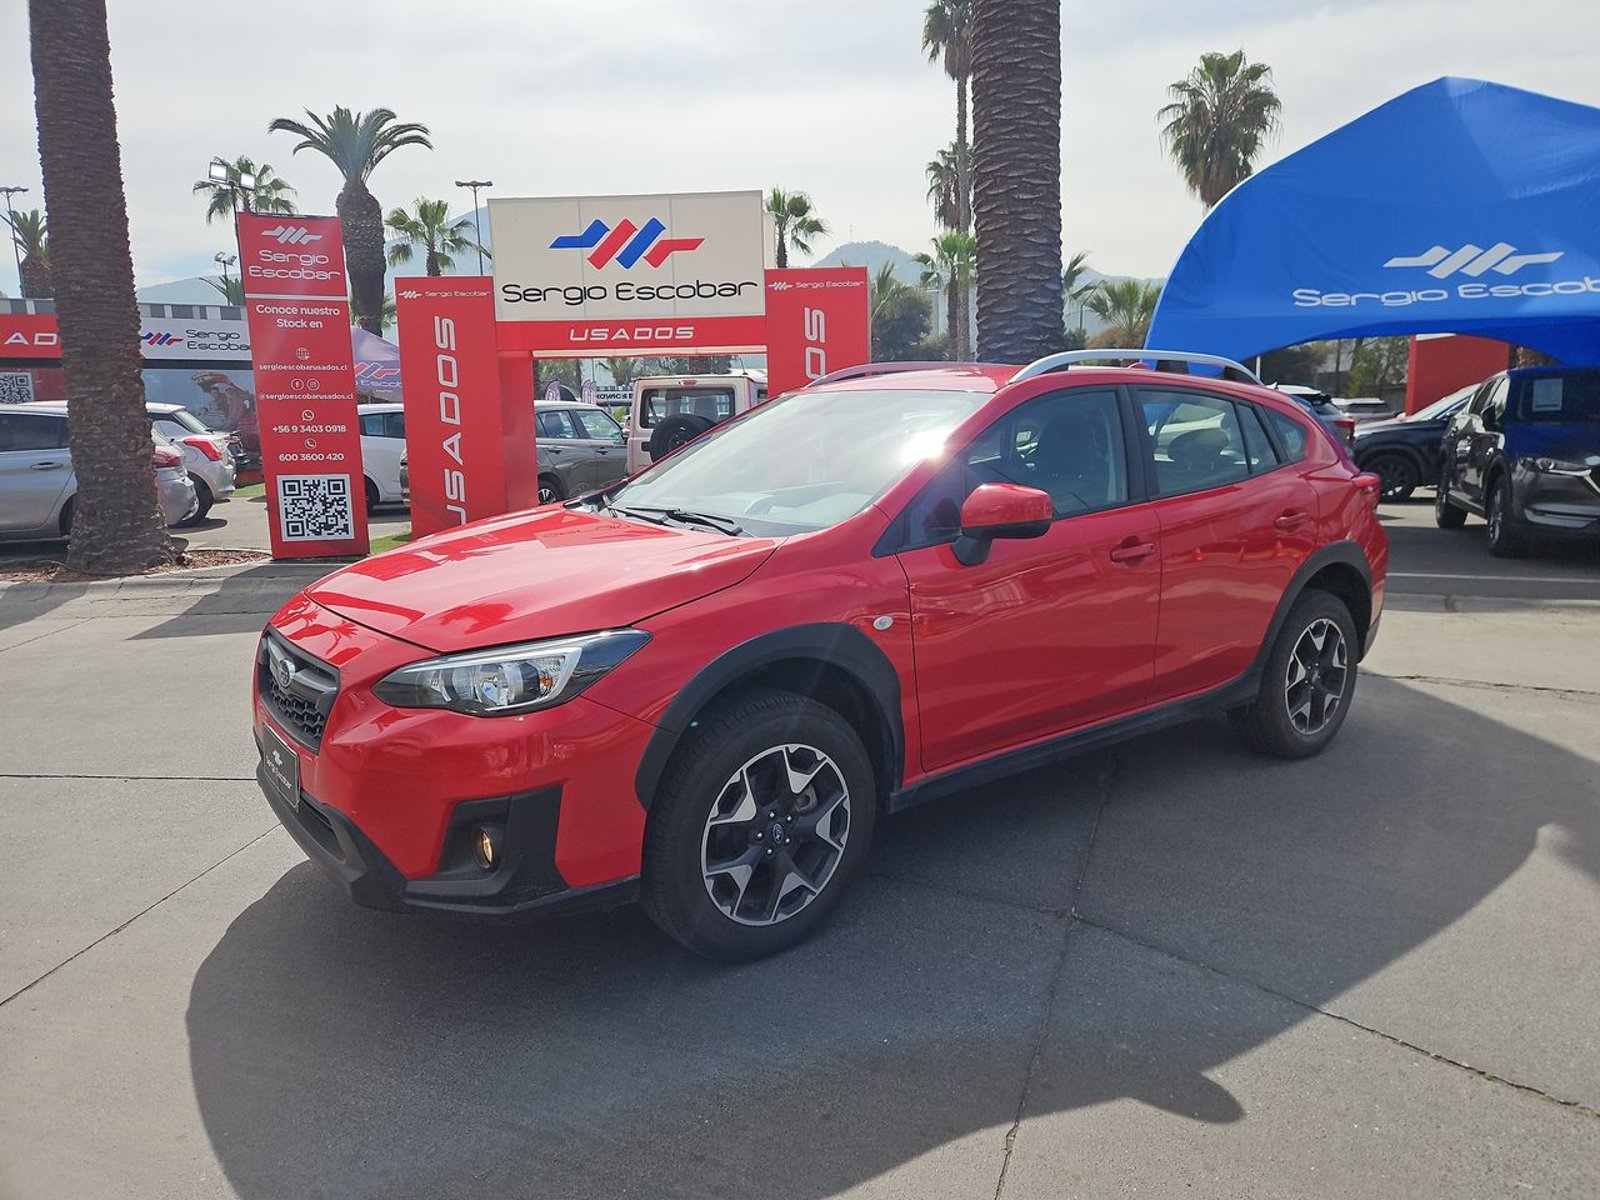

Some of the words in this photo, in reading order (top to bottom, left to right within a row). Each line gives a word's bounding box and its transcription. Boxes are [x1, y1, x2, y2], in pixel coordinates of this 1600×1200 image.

[259, 249, 329, 266] Sergio
[248, 265, 341, 280] Escobar
[795, 281, 825, 289] Sergio
[826, 280, 864, 288] Escobar
[425, 290, 453, 298] Sergio
[501, 283, 608, 306] Sergio
[615, 279, 758, 301] Escobar
[1292, 288, 1449, 307] Sergio
[1458, 276, 1600, 299] Escob
[255, 304, 298, 314] Conoce
[300, 306, 340, 315] nuestro
[276, 318, 307, 328] Stock
[309, 320, 323, 329] en
[185, 329, 241, 341] Sergio
[569, 326, 695, 341] USADOS
[187, 340, 251, 351] Escoba
[272, 424, 291, 433] +56
[291, 424, 299, 433] 9
[299, 424, 323, 433] 3403
[324, 424, 347, 433] 0918
[278, 453, 299, 462] 600
[299, 453, 325, 461] 3600
[325, 453, 345, 461] 420
